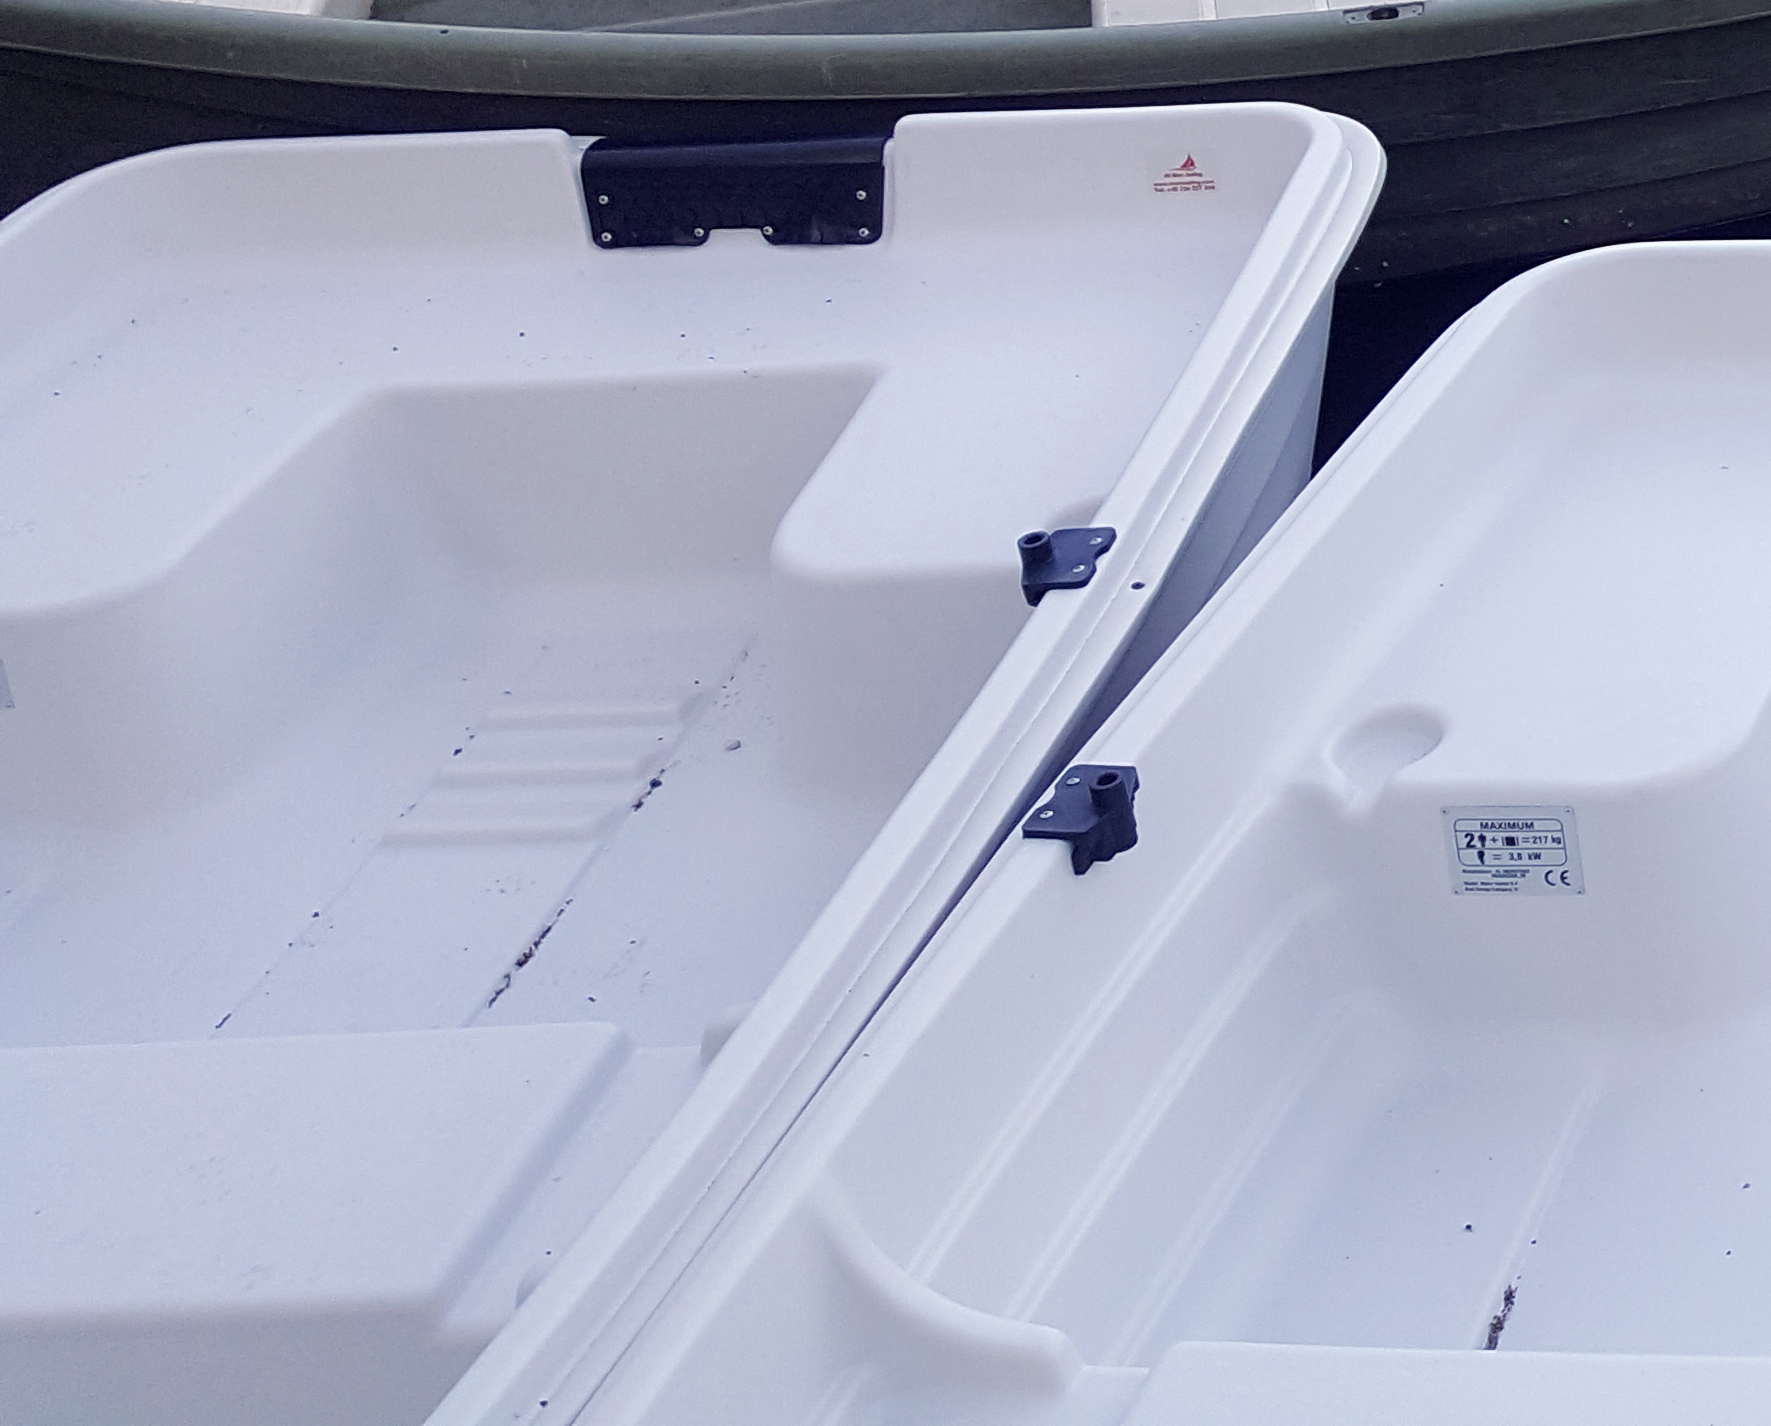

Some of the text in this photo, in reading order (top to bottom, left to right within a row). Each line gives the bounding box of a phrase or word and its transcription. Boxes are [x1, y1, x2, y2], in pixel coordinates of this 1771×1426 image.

[1479, 821, 1534, 830] MAXIMUM
[1464, 832, 1476, 849] 2
[1551, 834, 1562, 845] kg
[1528, 852, 1542, 861] kW
